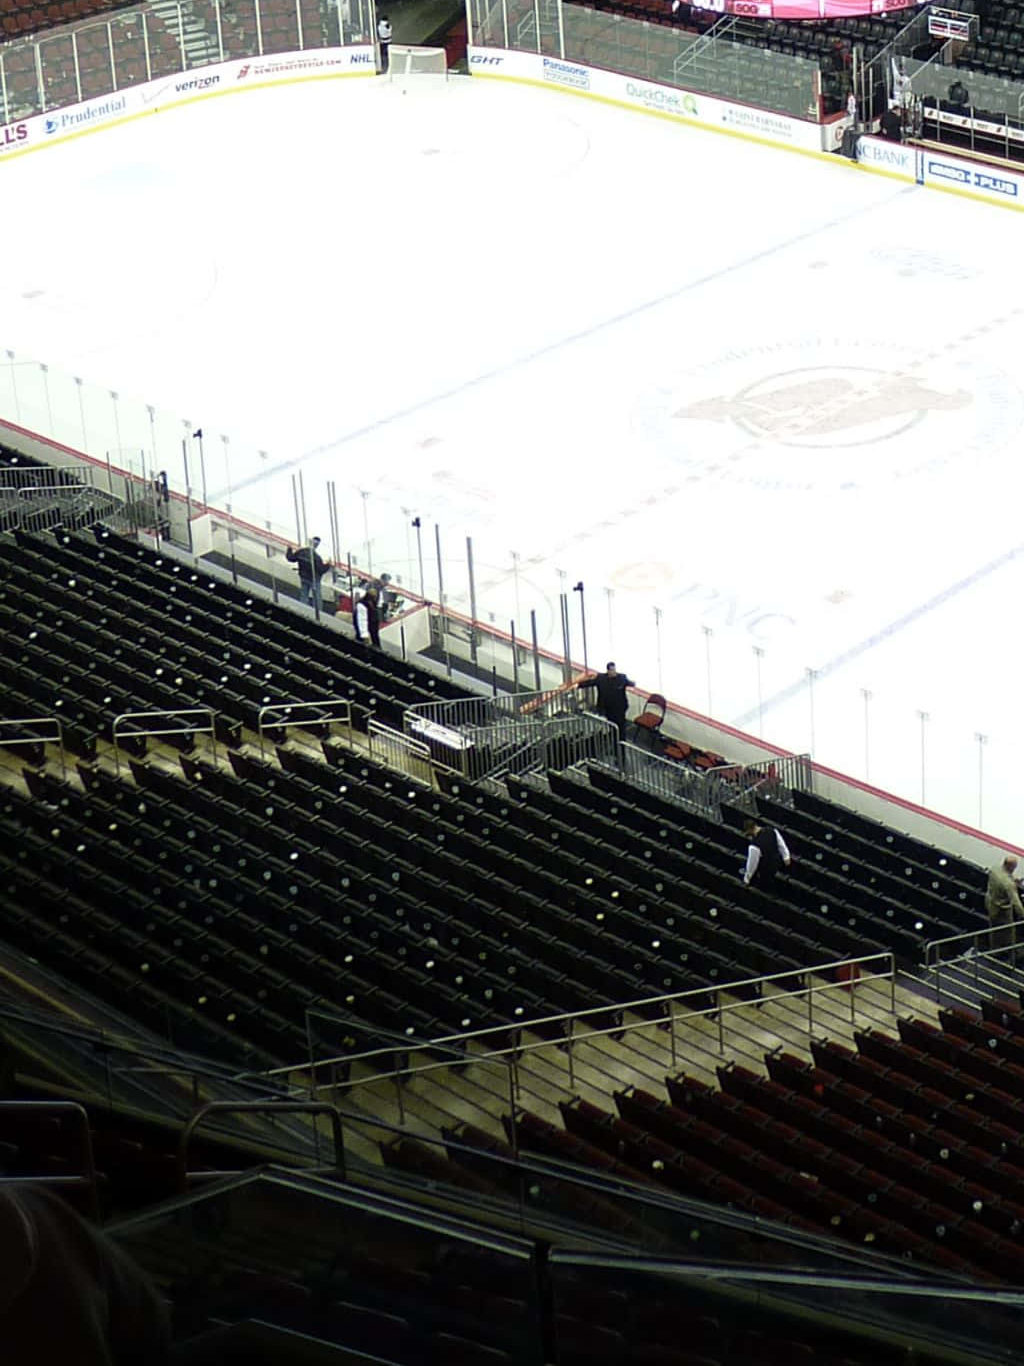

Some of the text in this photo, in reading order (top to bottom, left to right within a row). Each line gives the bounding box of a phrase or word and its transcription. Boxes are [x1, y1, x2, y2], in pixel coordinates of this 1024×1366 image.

[736, 2, 759, 14] SOG
[350, 54, 374, 65] NHL
[542, 58, 589, 76] Panasonic
[175, 74, 220, 92] verizon
[61, 96, 126, 127] Prudential
[873, 146, 910, 166] BANK
